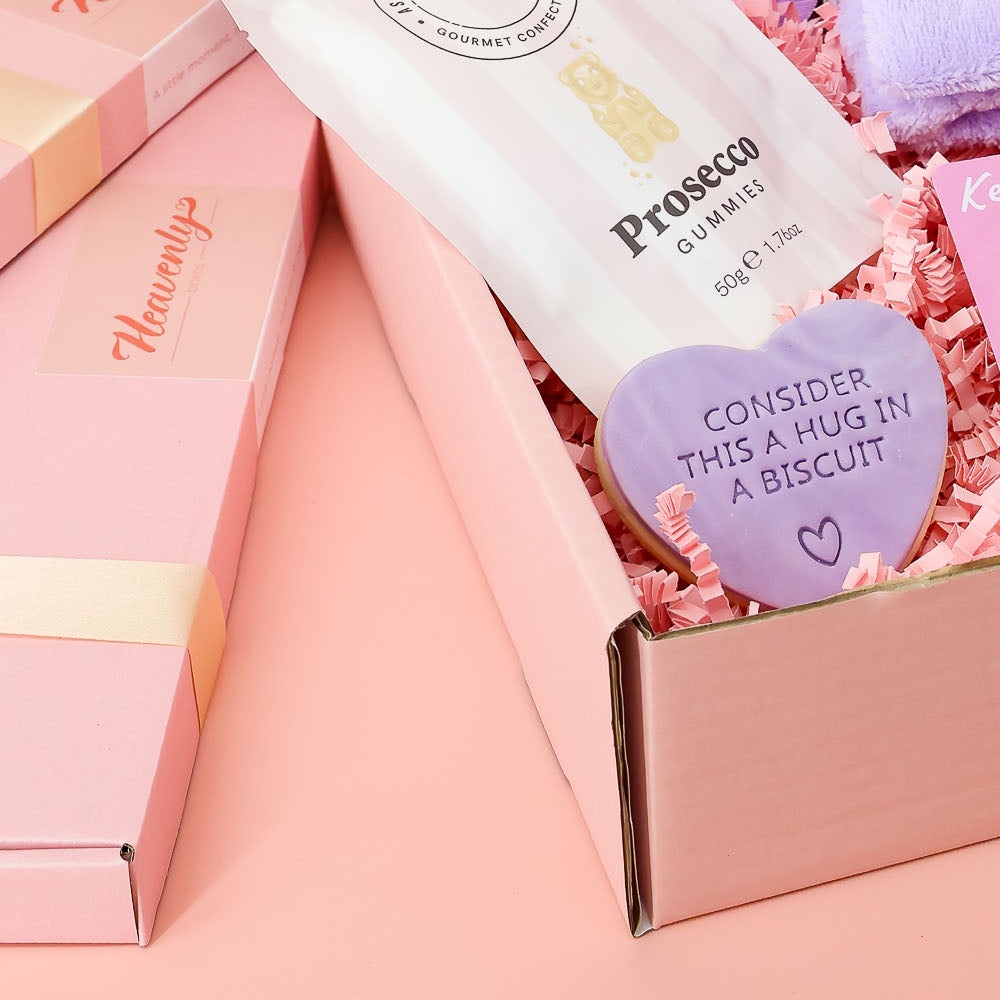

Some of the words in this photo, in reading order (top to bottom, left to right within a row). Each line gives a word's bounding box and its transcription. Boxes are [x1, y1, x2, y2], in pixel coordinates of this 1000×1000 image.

[436, 27, 513, 48] GOURMET
[609, 136, 760, 259] Prosecco
[676, 178, 765, 255] GUMMIES
[111, 196, 213, 361] Heavenly
[714, 268, 750, 297] 50g
[763, 223, 803, 254] 1.76oz
[677, 436, 755, 480] THIS
[765, 429, 788, 455] A
[794, 404, 867, 445] HUG
[874, 391, 913, 424] IN
[702, 366, 873, 433] CONSIDER
[731, 477, 754, 504] A
[760, 435, 885, 495] BISCUIT
